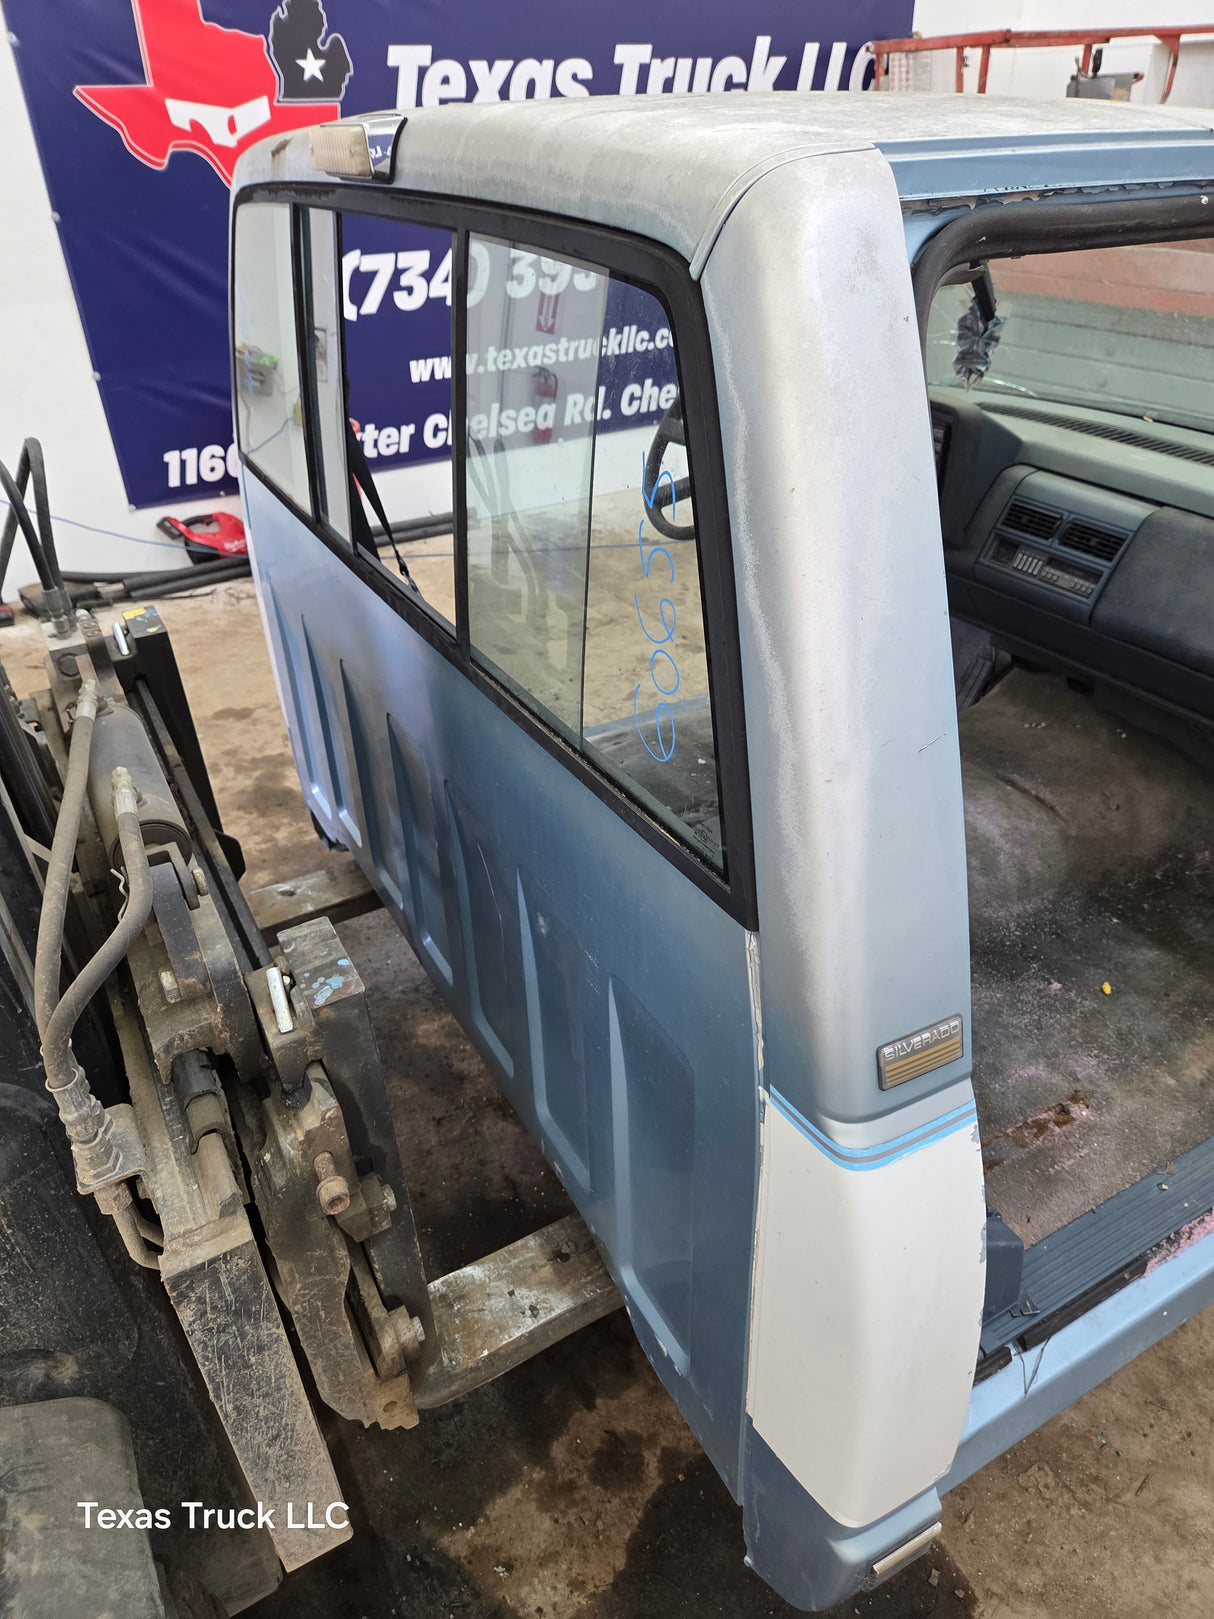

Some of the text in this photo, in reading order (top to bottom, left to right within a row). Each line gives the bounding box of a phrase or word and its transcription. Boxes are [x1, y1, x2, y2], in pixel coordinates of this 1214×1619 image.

[387, 45, 593, 110] Texas
[613, 35, 788, 96] Truck
[409, 324, 675, 384] www.texastruckllc.c
[883, 1020, 960, 1061] SILVERADO
